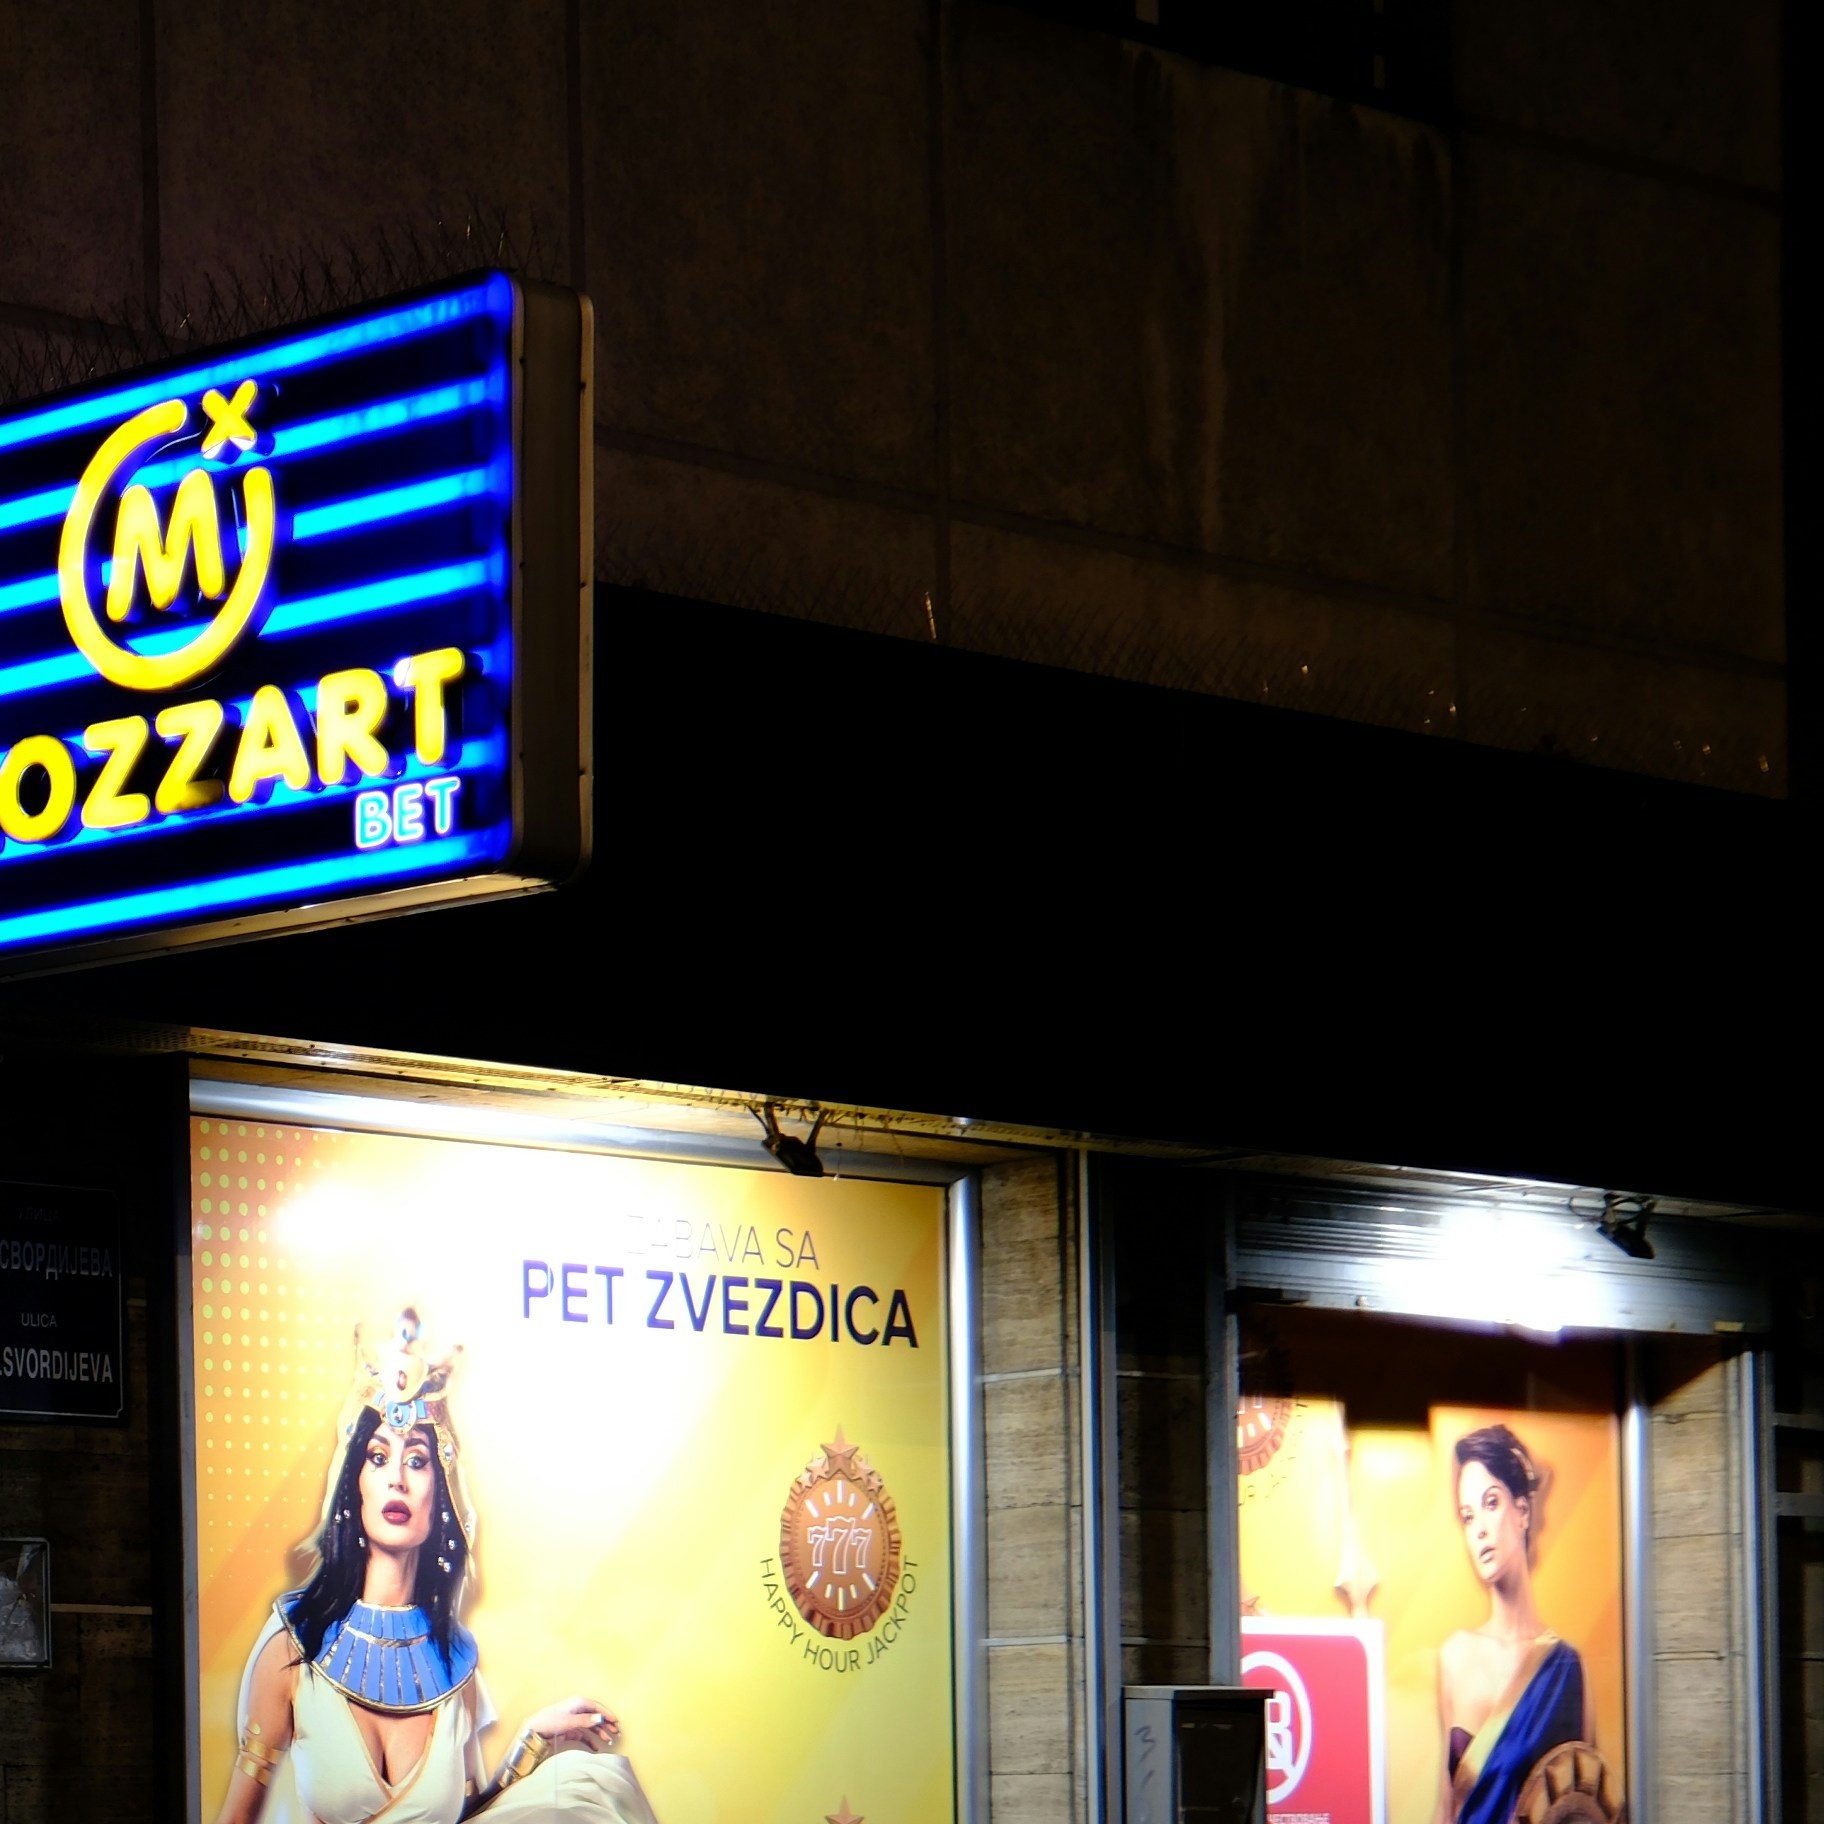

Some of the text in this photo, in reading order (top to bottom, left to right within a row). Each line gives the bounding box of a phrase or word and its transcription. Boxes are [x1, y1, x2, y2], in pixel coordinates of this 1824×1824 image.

[354, 776, 460, 849] BET
[775, 1227, 819, 1271] SA
[20, 1312, 58, 1328] ULICA
[522, 1258, 919, 1349] PET ZVEZDICA
[760, 1554, 919, 1673] HAPPY HOUR JACKPOT
